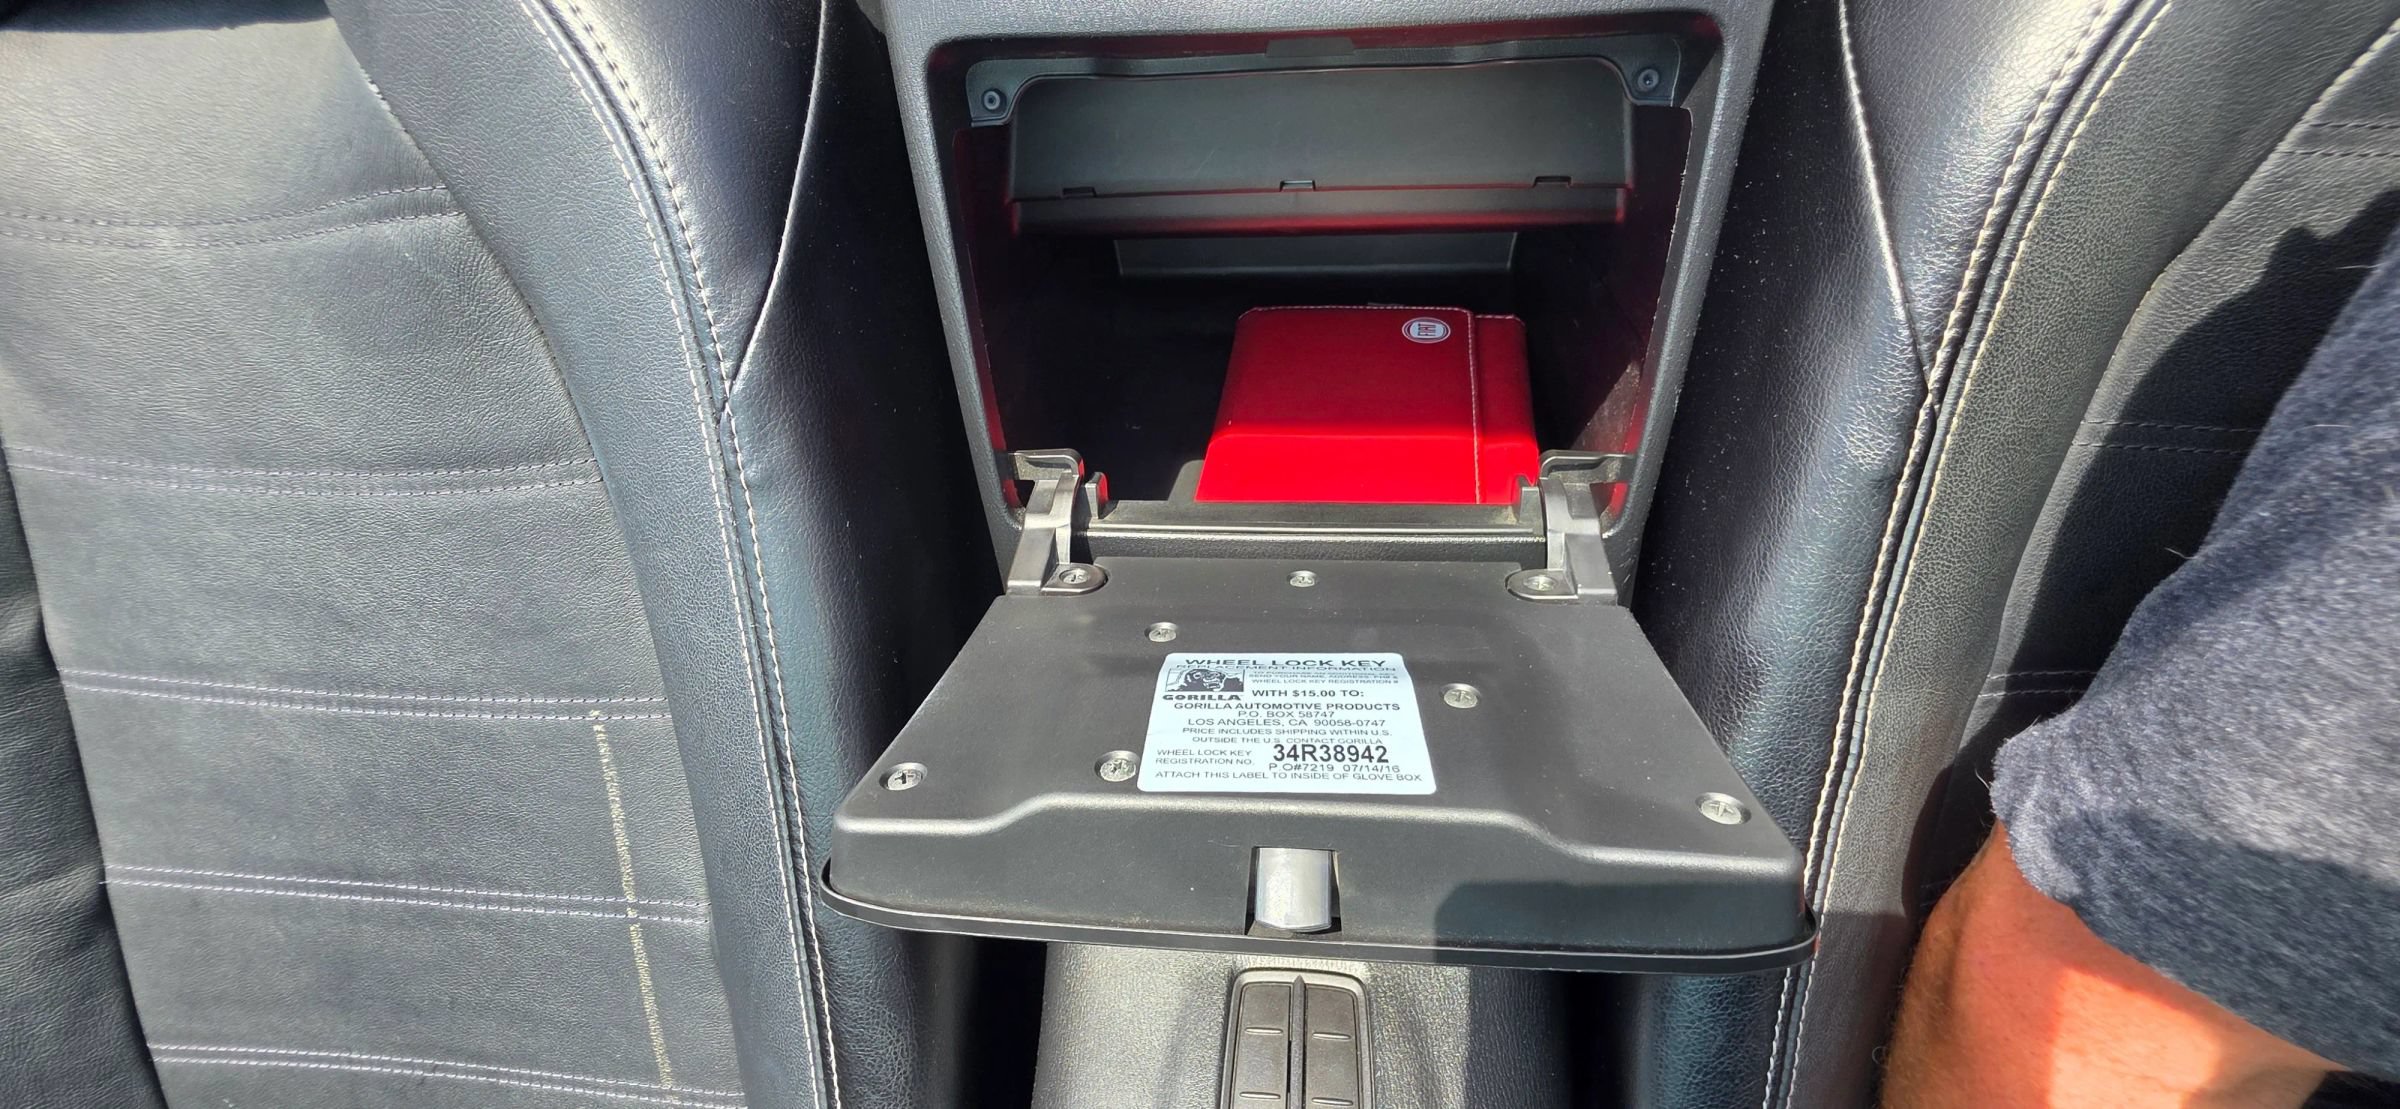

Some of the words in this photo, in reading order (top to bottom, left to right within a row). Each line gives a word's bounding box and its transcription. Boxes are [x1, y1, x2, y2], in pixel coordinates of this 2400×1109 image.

[1418, 323, 1436, 336] FIAT
[1326, 703, 1400, 711] PRODUCTS
[1188, 718, 1214, 726] LOS
[1217, 718, 1285, 727] ANGELES,
[1314, 719, 1386, 727] 90058-0747
[1230, 749, 1252, 757] KEY
[1273, 743, 1389, 763] 34R38942
[1155, 757, 1233, 765] REGISTRATION
[1343, 764, 1400, 773] 07/14/16
[1204, 771, 1229, 779] THIS
[1232, 771, 1269, 779] LABEL
[1290, 772, 1329, 780] INSIDE
[1333, 772, 1347, 780] OF
[1352, 773, 1393, 781] GLOVE
[1396, 773, 1423, 781] BOX
